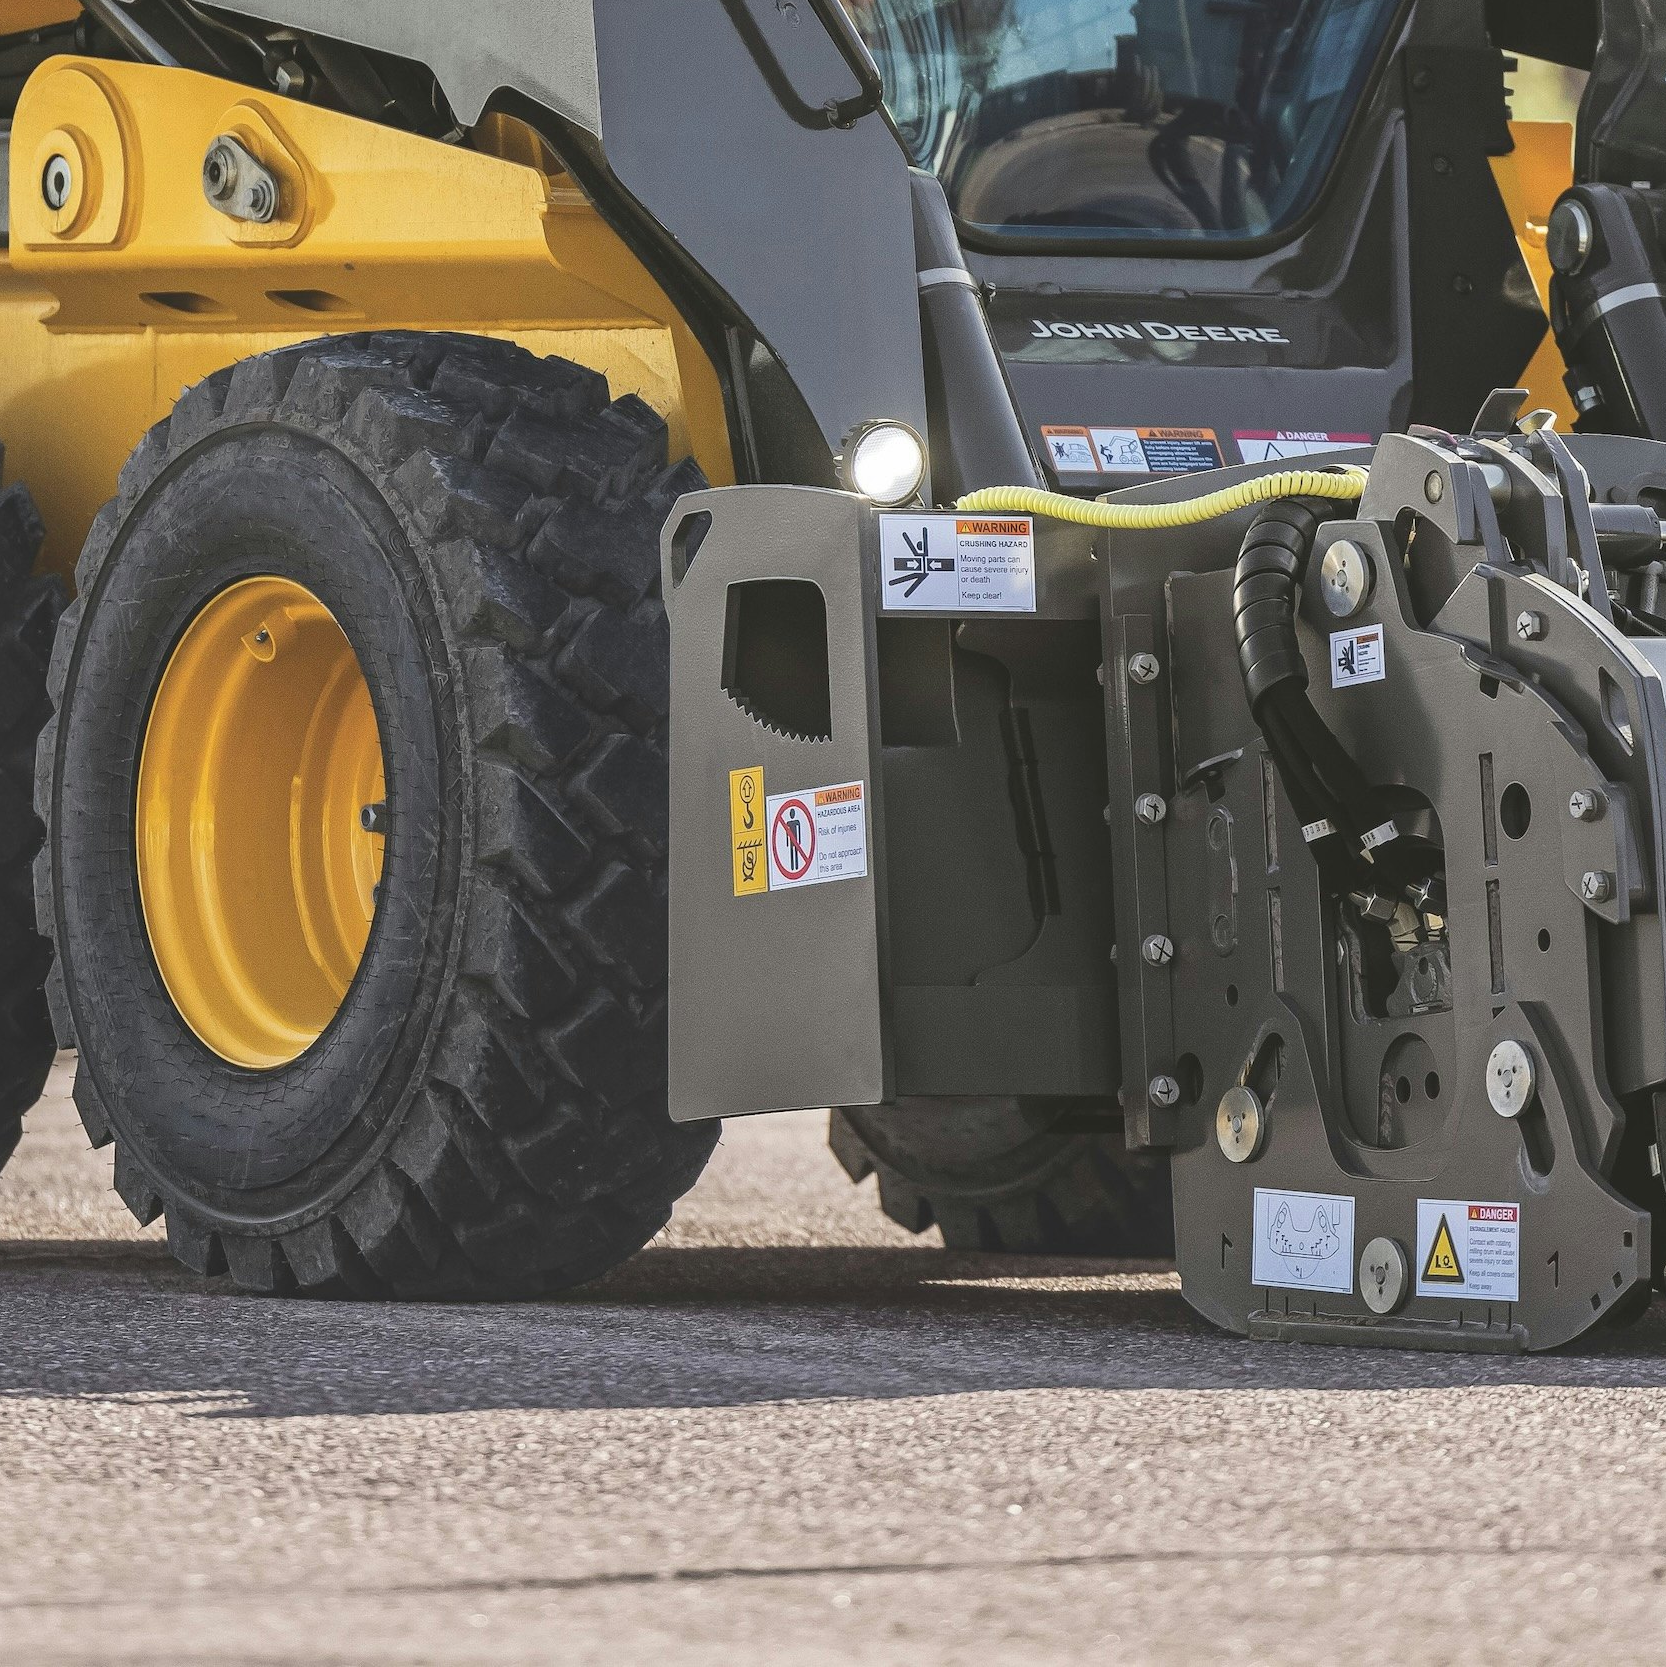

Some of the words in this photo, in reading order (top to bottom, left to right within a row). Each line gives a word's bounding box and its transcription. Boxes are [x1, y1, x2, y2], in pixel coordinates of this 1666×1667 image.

[1031, 319, 1144, 340] JOHN
[1140, 321, 1290, 344] DEERE
[1158, 430, 1204, 438] WARNING
[1285, 432, 1329, 441] DANGER
[972, 523, 1027, 533] WARNING
[960, 555, 986, 564] Moving
[1009, 566, 1029, 575] injury
[961, 592, 981, 600] Keep
[825, 787, 860, 802] WARNING
[817, 807, 847, 818] HAZARDOUS
[848, 804, 860, 813] AREA
[818, 827, 830, 836] Risk
[831, 825, 837, 835] of
[838, 823, 857, 836] injuries
[819, 852, 827, 860] Do
[828, 850, 837, 859] not
[838, 847, 862, 859] approach
[820, 865, 829, 873] this
[830, 863, 843, 871] area
[1480, 1208, 1513, 1220] DANGER
[1469, 1248, 1482, 1256] milling
[1481, 1284, 1492, 1292] away
